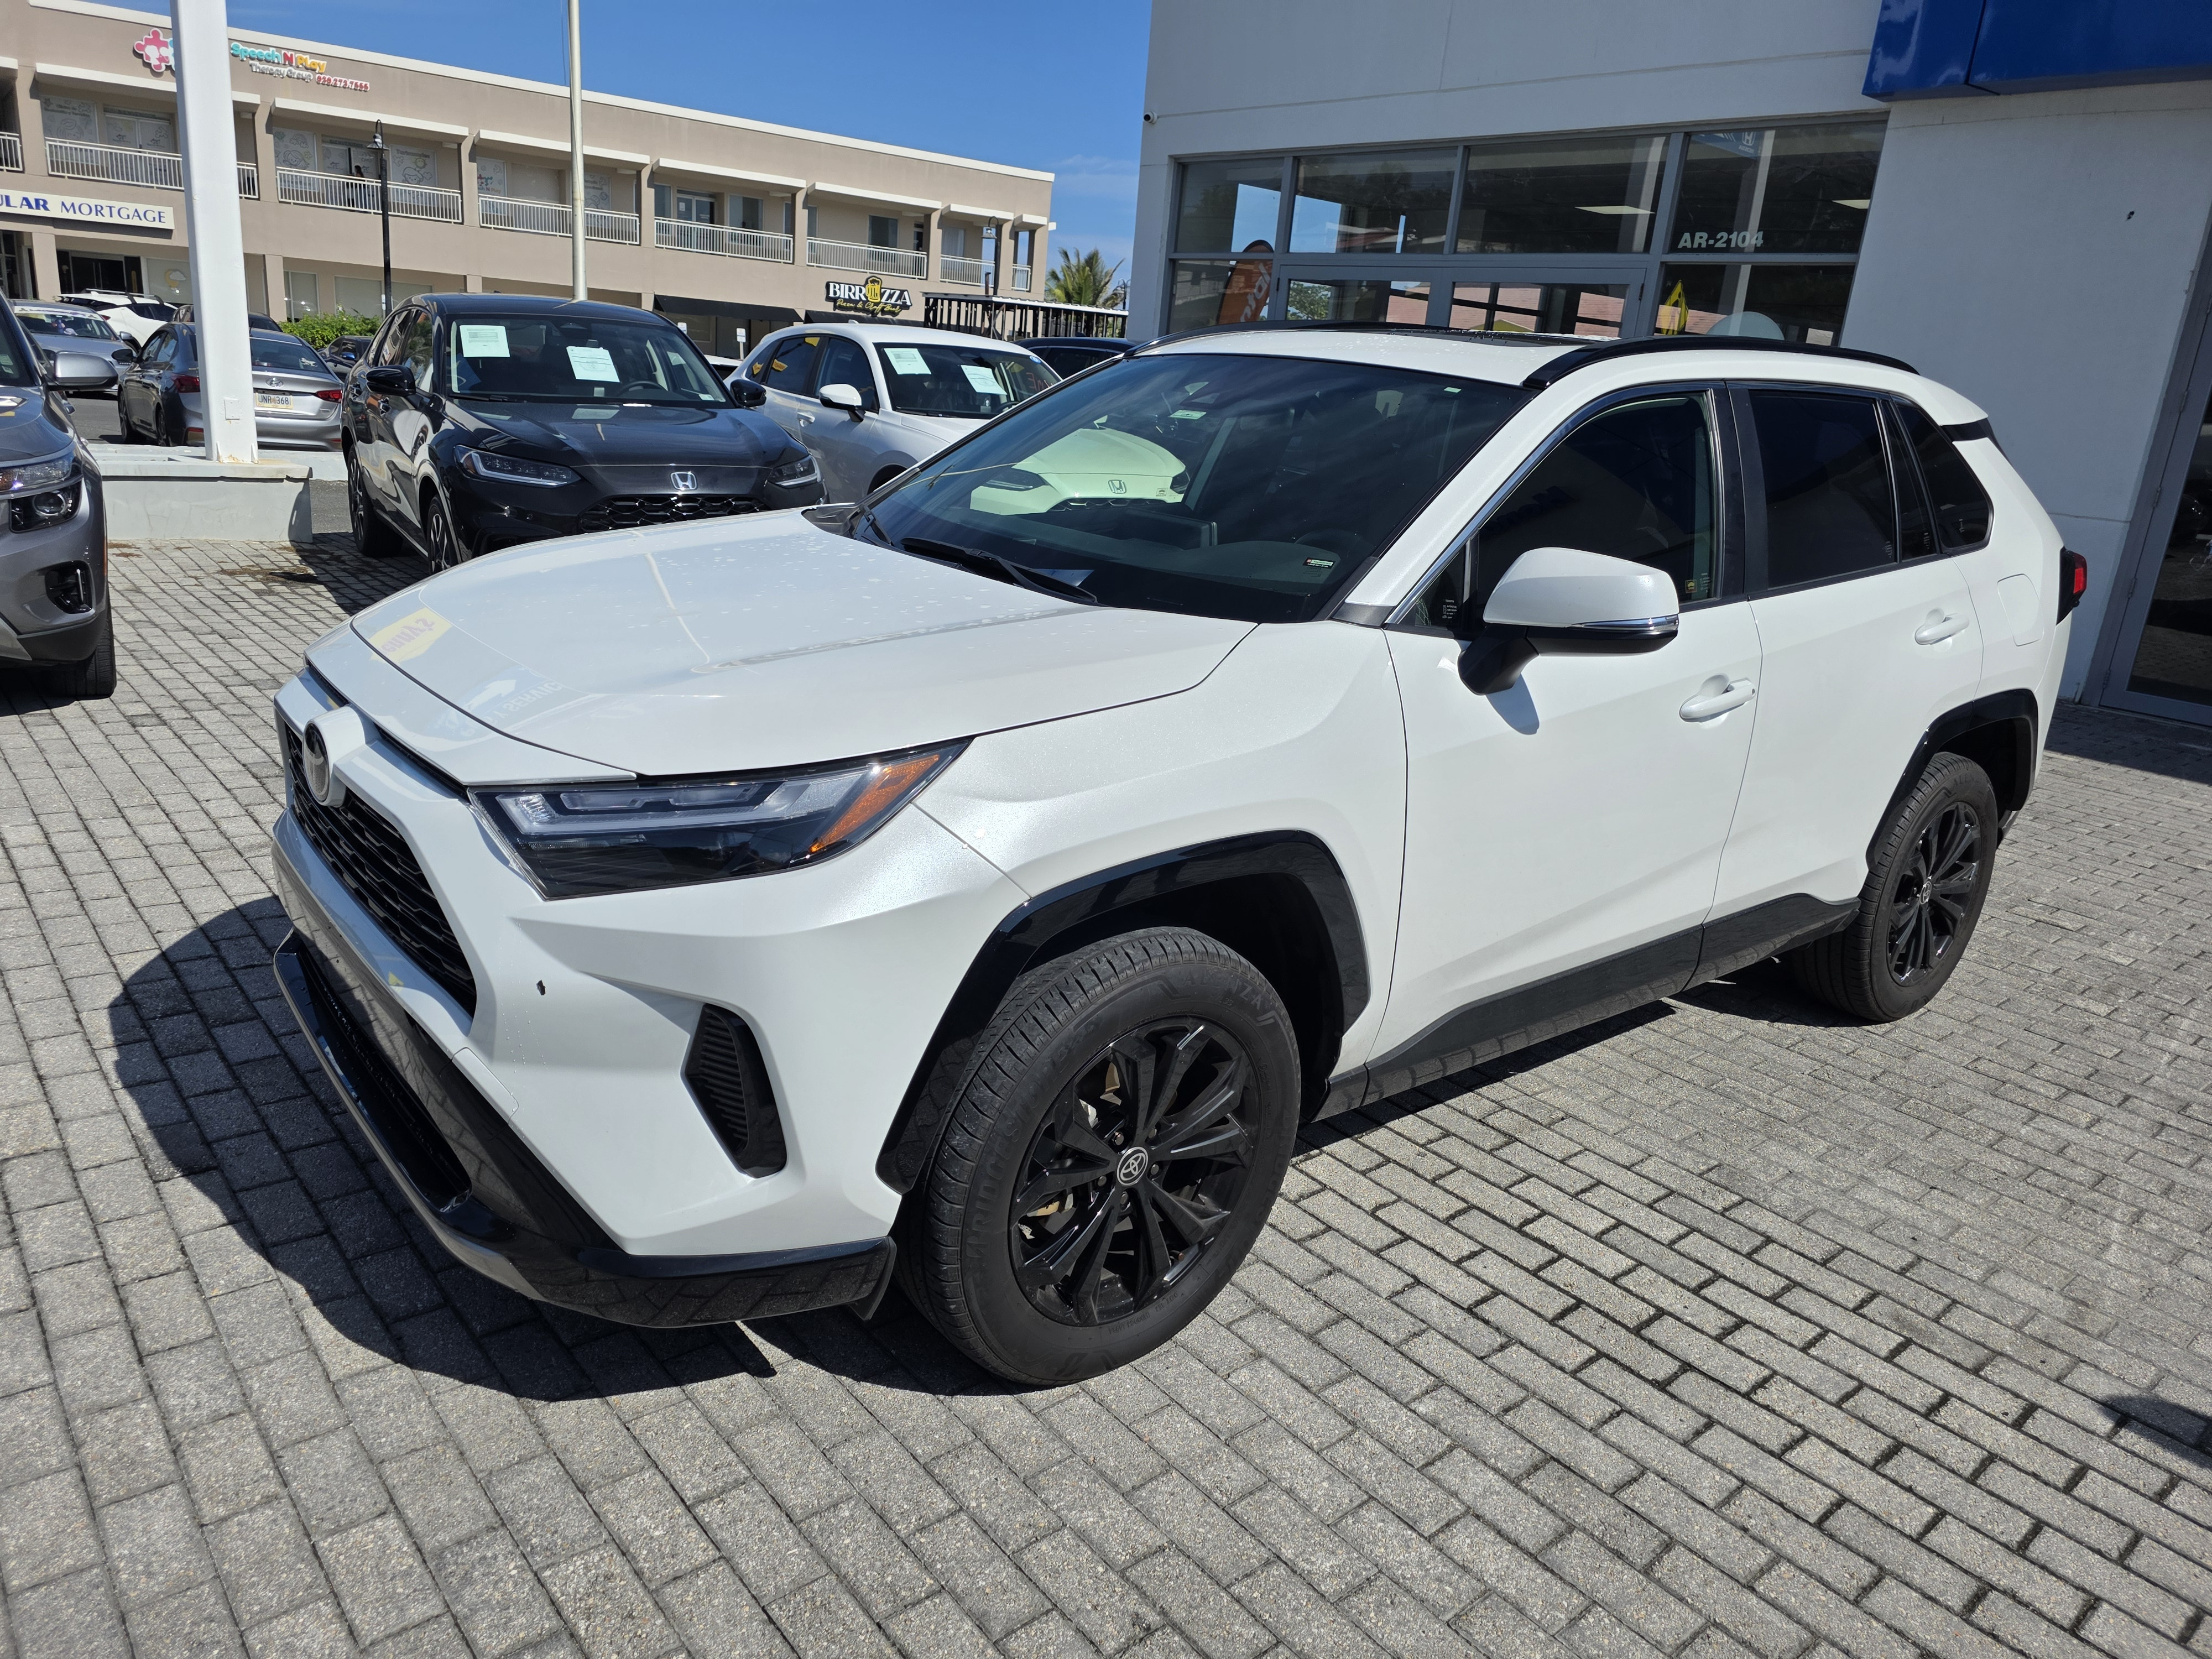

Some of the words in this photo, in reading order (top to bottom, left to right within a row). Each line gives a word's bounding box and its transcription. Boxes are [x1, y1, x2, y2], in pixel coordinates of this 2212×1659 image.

[231, 43, 281, 64] Speech
[283, 51, 295, 66] N
[296, 55, 327, 72] Play
[249, 61, 286, 77] Therapy
[286, 67, 313, 82] Group
[60, 201, 166, 224] MORTGAGE
[1677, 231, 1764, 248] AR-2104
[259, 395, 272, 404] JNR
[276, 396, 289, 405] 368
